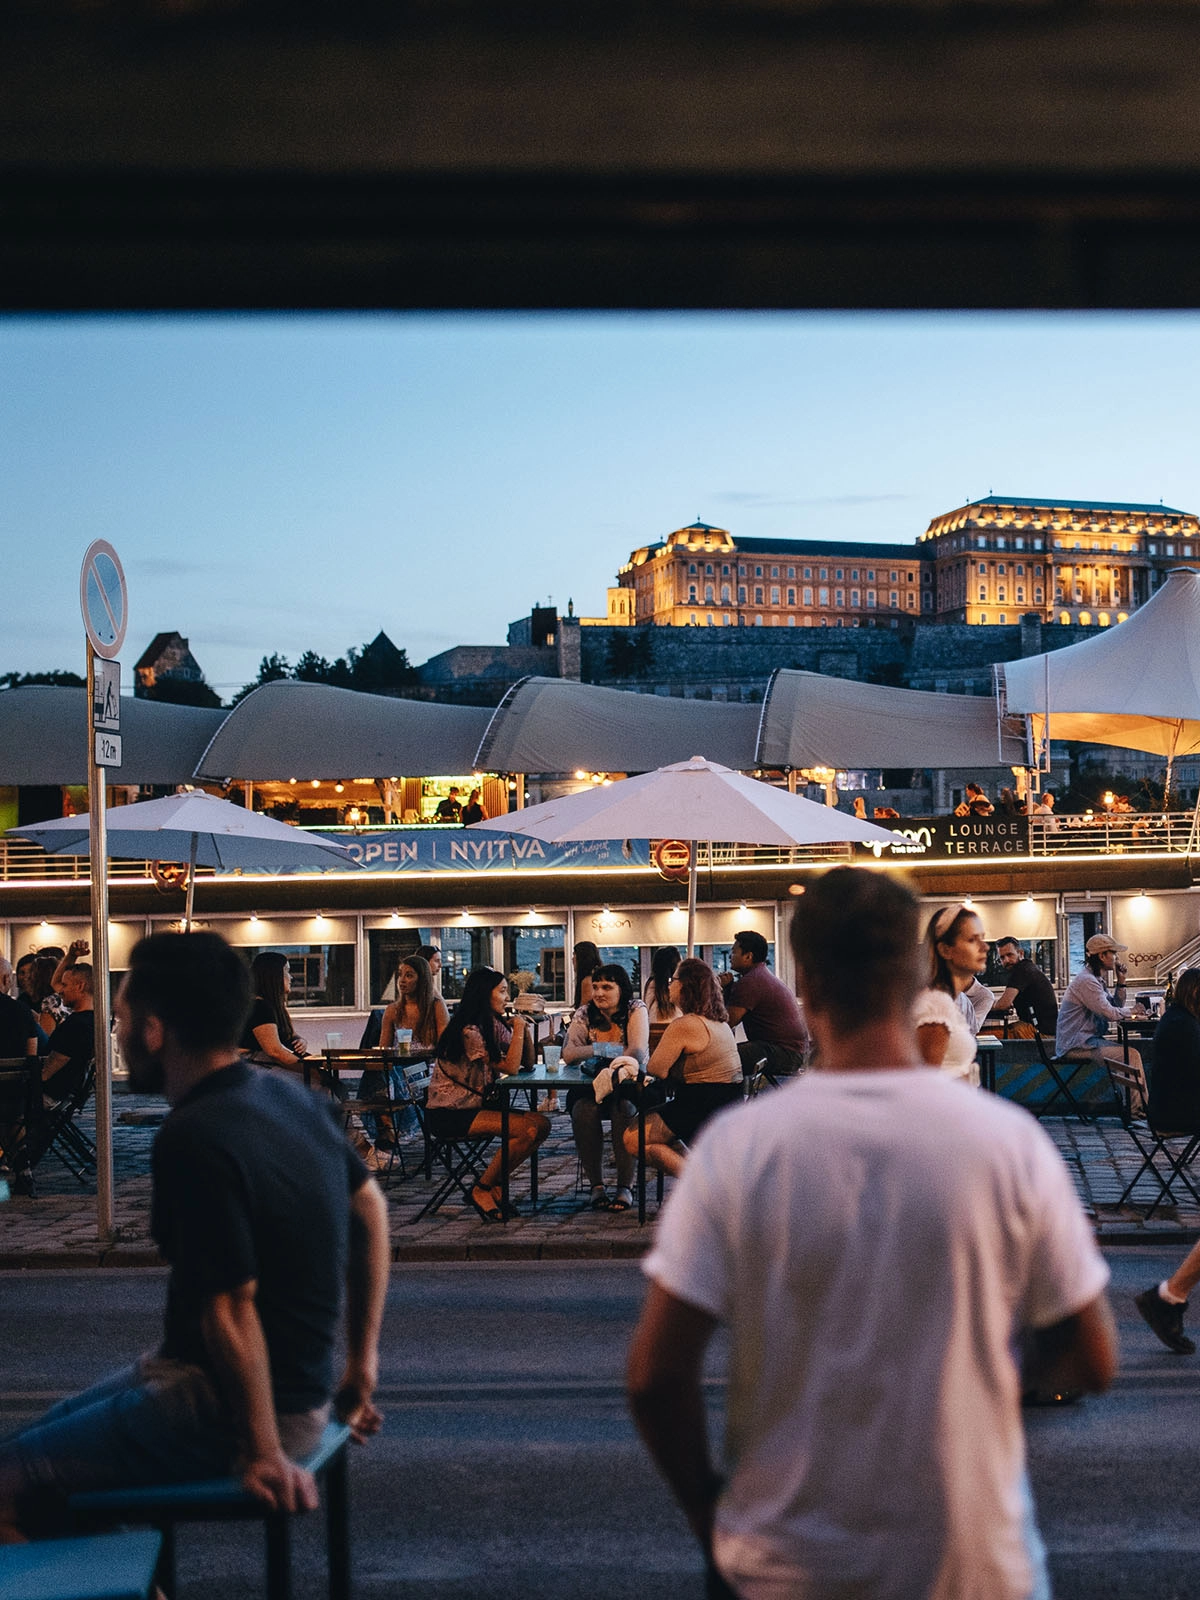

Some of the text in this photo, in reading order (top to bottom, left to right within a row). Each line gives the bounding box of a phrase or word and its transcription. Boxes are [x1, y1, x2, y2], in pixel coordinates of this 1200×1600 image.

[950, 823, 1019, 837] LOUNGE
[347, 838, 546, 863] OPEN NYITVA
[945, 840, 1024, 855] TERRACE
